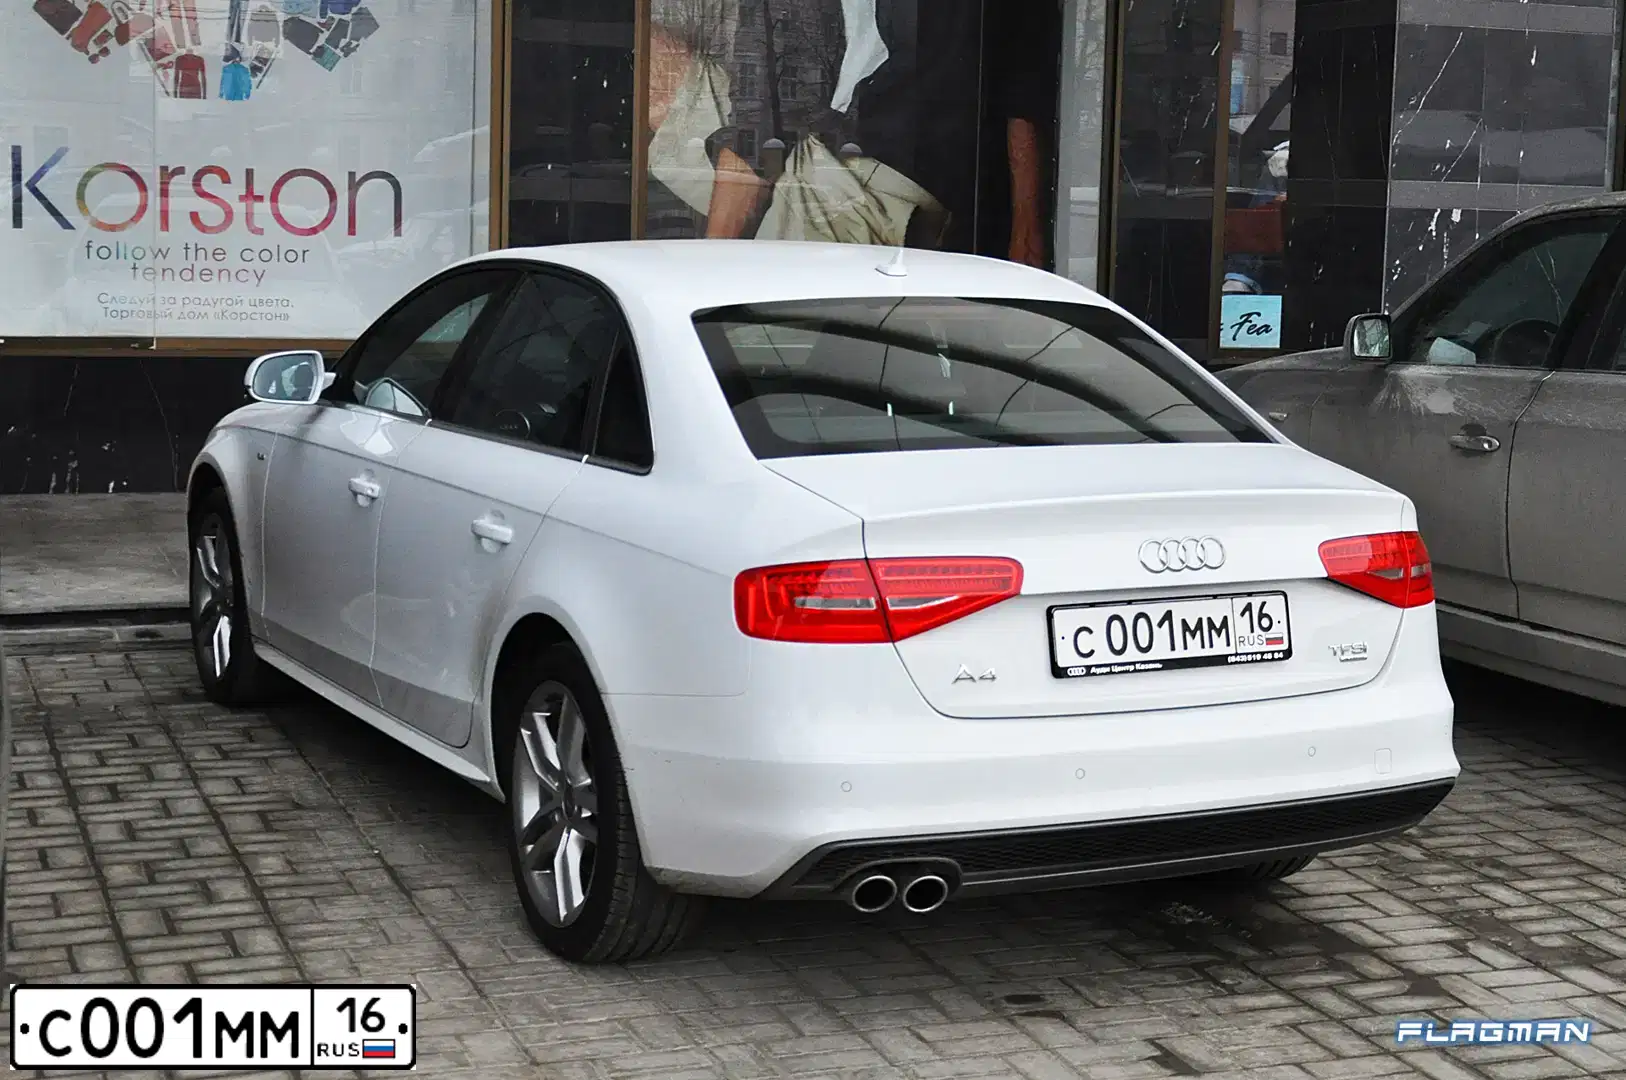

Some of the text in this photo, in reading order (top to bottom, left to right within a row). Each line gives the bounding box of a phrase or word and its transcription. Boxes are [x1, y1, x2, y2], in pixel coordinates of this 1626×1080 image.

[11, 145, 402, 237] Korston
[85, 240, 310, 263] follow the color
[131, 262, 266, 287] tendency
[97, 292, 155, 306] Следуй
[160, 296, 177, 306] за
[182, 295, 243, 309] радугой
[103, 306, 172, 320] Торговый
[177, 309, 209, 321] дом
[1240, 601, 1273, 633] 16
[1239, 634, 1265, 647] RUS
[951, 664, 997, 684] A4
